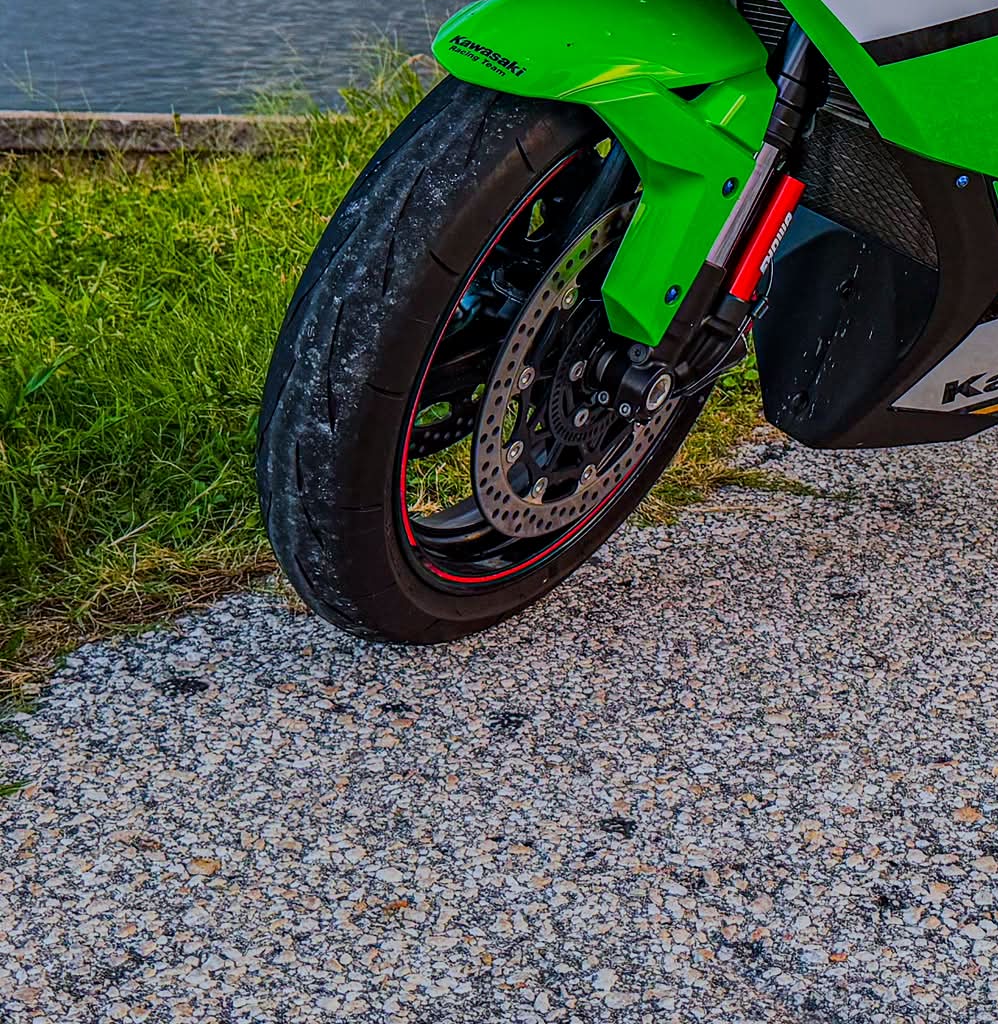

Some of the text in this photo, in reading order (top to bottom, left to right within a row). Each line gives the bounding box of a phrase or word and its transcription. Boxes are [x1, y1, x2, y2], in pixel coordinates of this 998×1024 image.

[448, 34, 527, 78] Kawasaki
[448, 44, 507, 77] Racing Team
